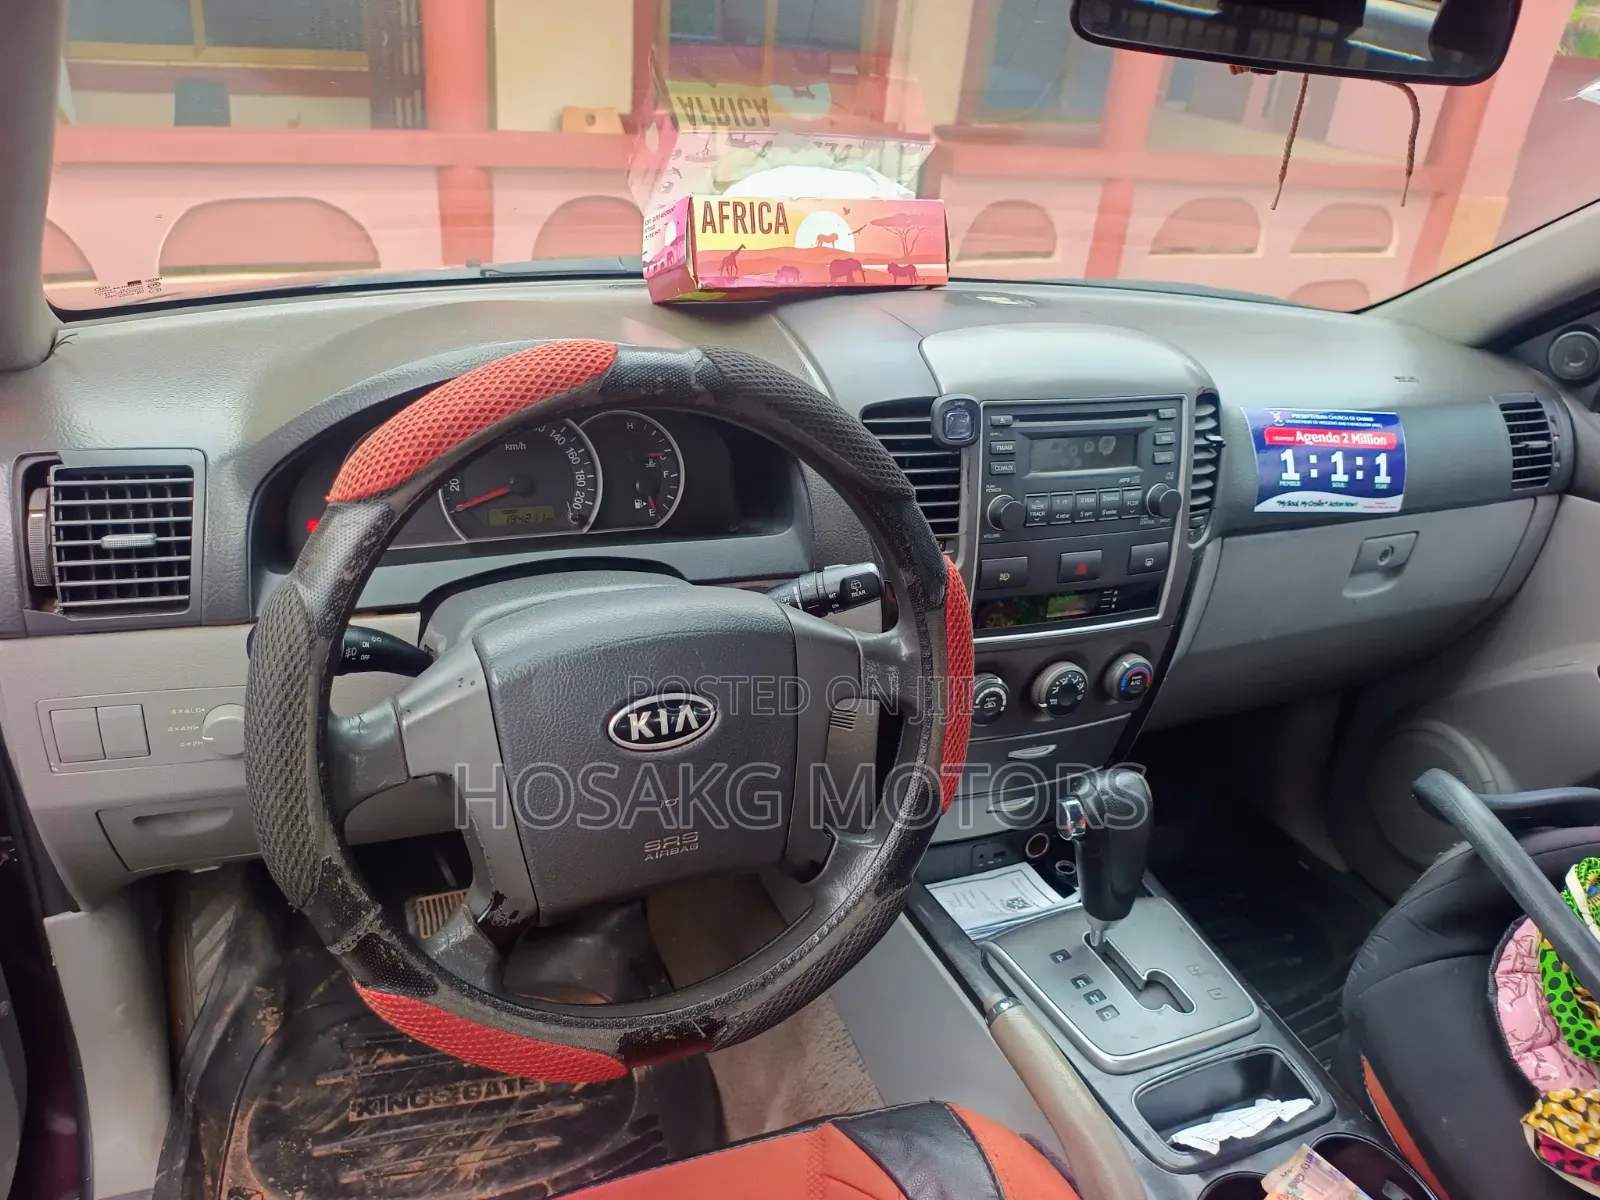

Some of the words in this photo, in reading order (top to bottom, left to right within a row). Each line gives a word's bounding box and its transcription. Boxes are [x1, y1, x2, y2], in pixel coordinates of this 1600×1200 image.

[701, 201, 789, 234] AFRICA
[627, 422, 633, 430] H
[549, 429, 566, 445] 140
[1295, 431, 1340, 445] Agenda
[1342, 433, 1349, 443] 2
[1352, 433, 1387, 445] Million
[505, 442, 526, 452] km/h
[566, 447, 580, 465] 160
[450, 478, 460, 492] 20
[575, 469, 586, 487] 180
[572, 490, 586, 510] 200
[649, 509, 655, 517] E
[851, 590, 867, 598] REAR
[628, 704, 699, 741] KIA
[644, 832, 699, 852] SRS
[644, 843, 699, 861] AIRBAG
[1056, 954, 1064, 963] P
[1076, 979, 1086, 988] R
[1090, 994, 1099, 1003] N
[1103, 1011, 1112, 1020] D
